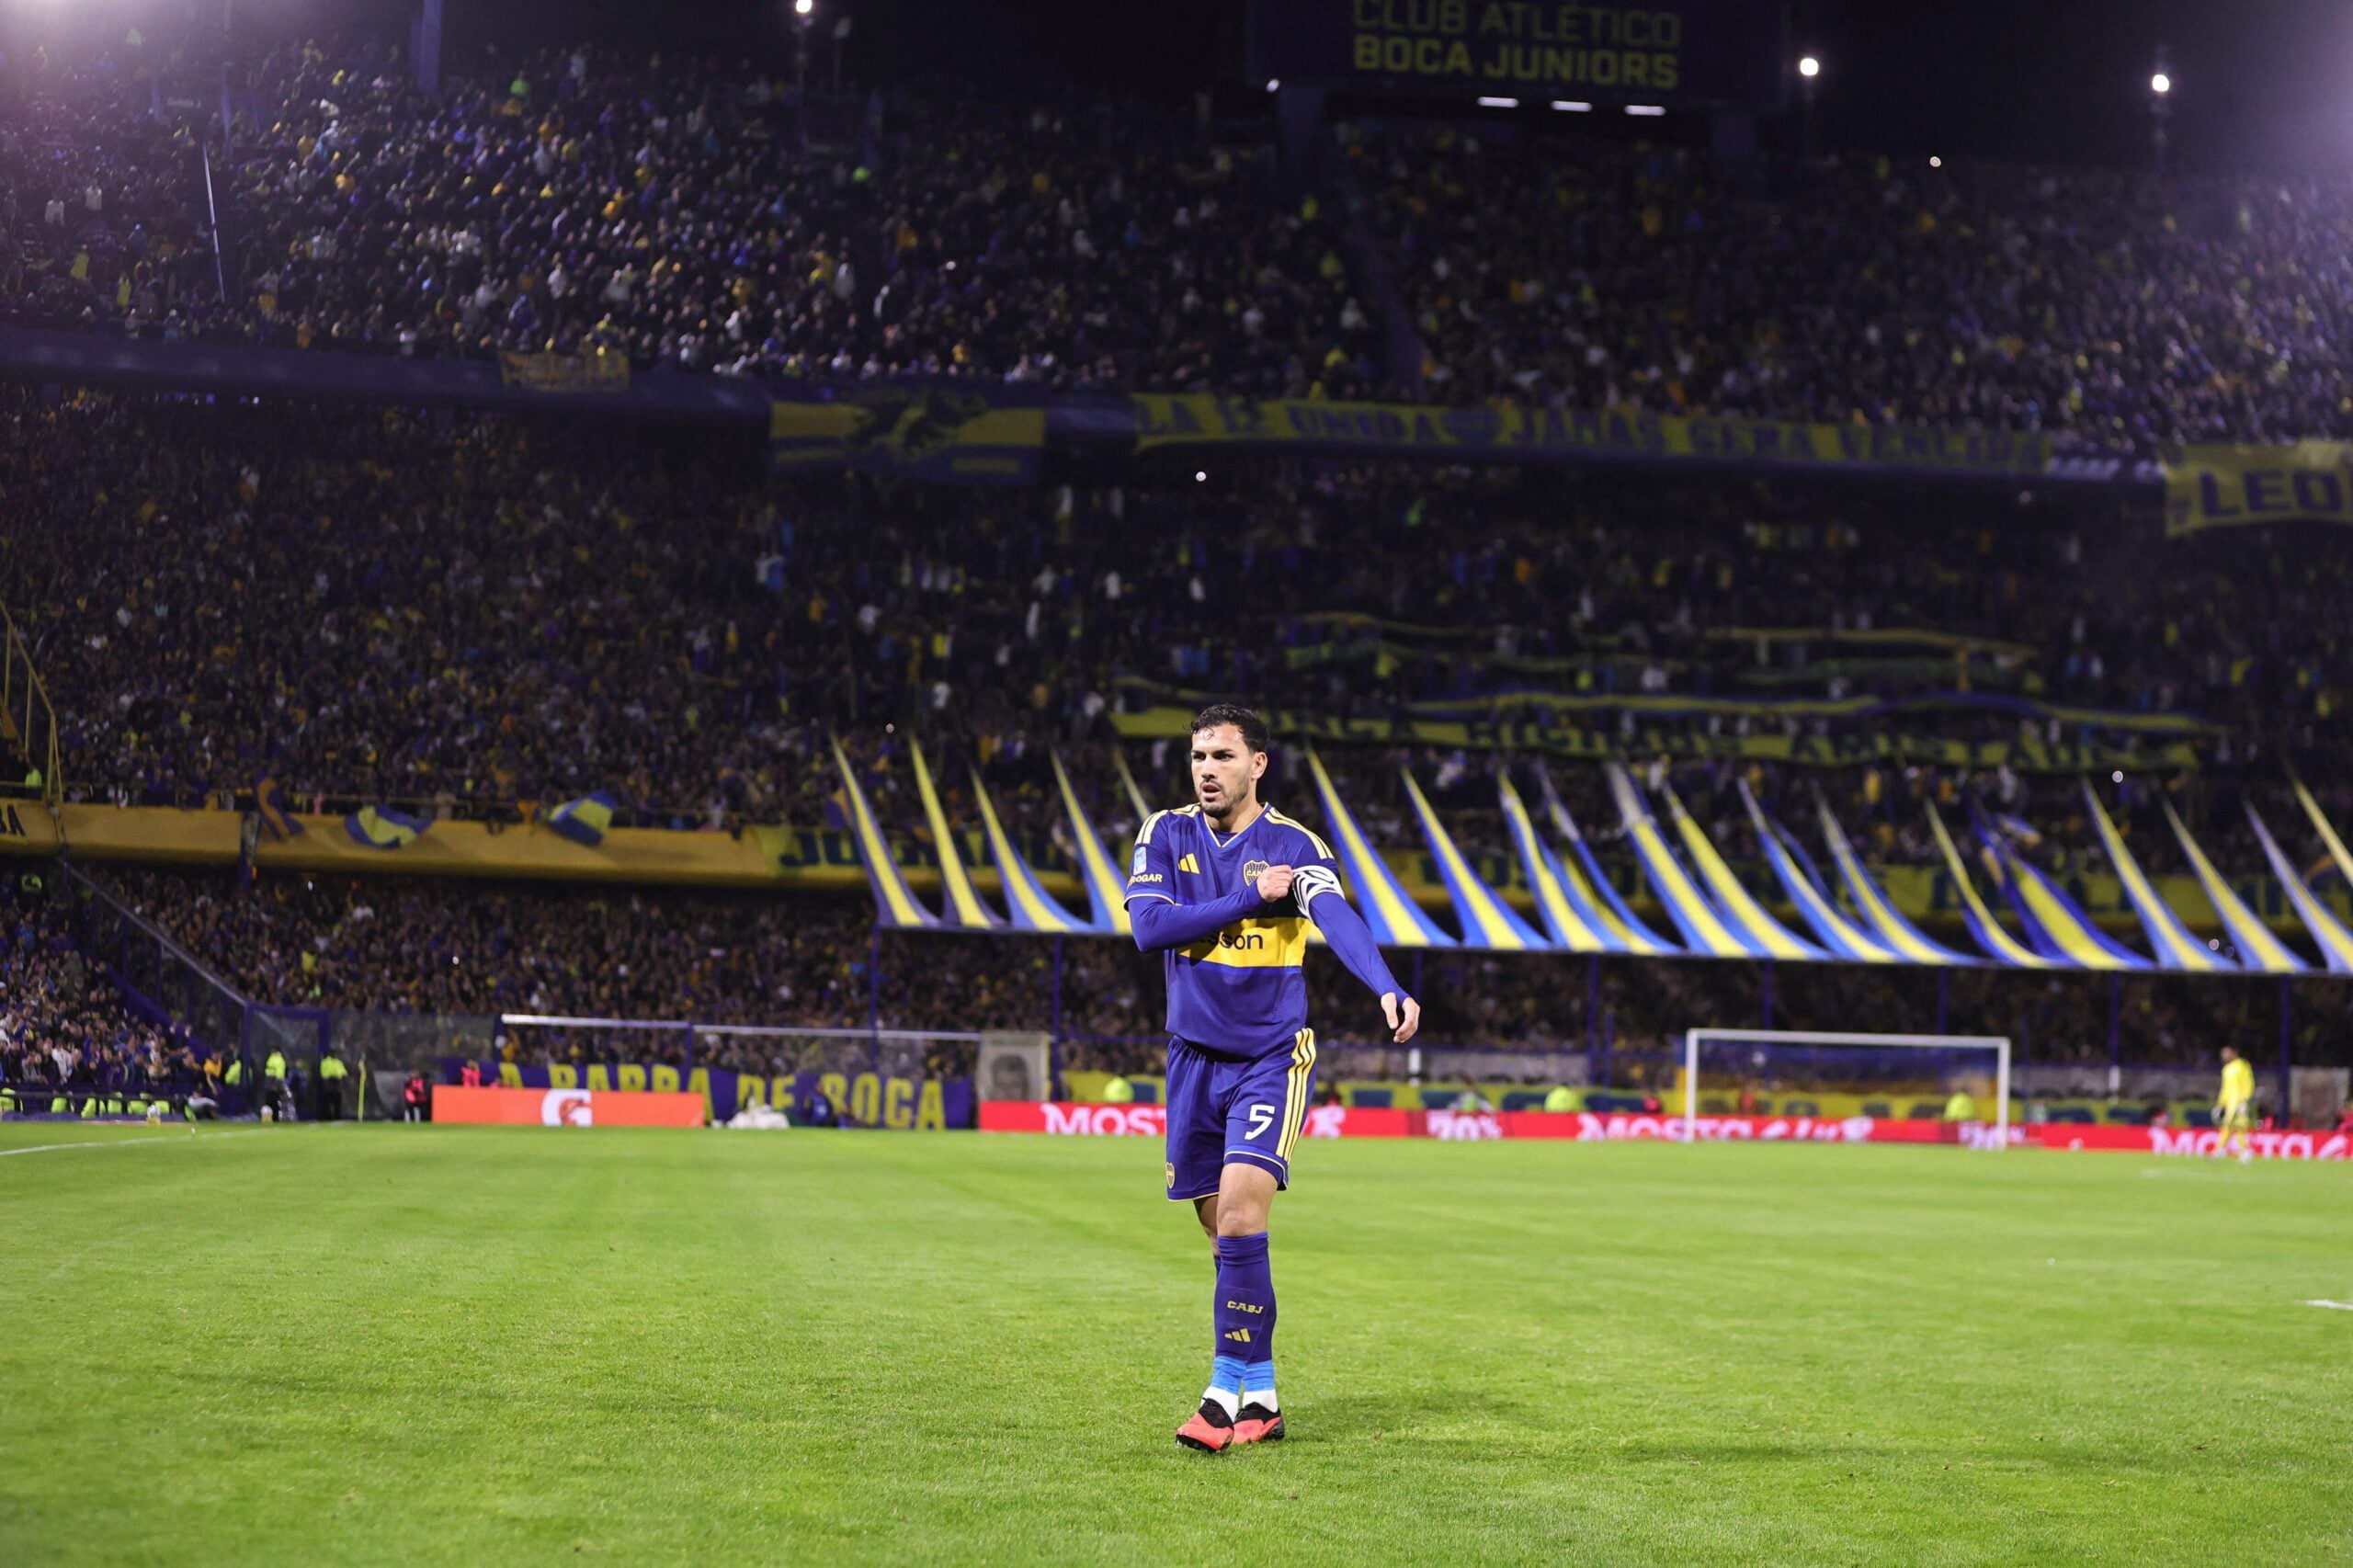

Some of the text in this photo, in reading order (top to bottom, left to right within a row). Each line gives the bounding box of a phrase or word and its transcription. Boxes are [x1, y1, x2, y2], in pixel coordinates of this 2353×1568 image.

[1352, 0, 1468, 34] CLUB
[1353, 34, 1679, 89] BOCA JUNIORS
[821, 1072, 948, 1131] BOCA
[1245, 1104, 1276, 1141] 5
[1227, 1300, 1264, 1314] CABJ
